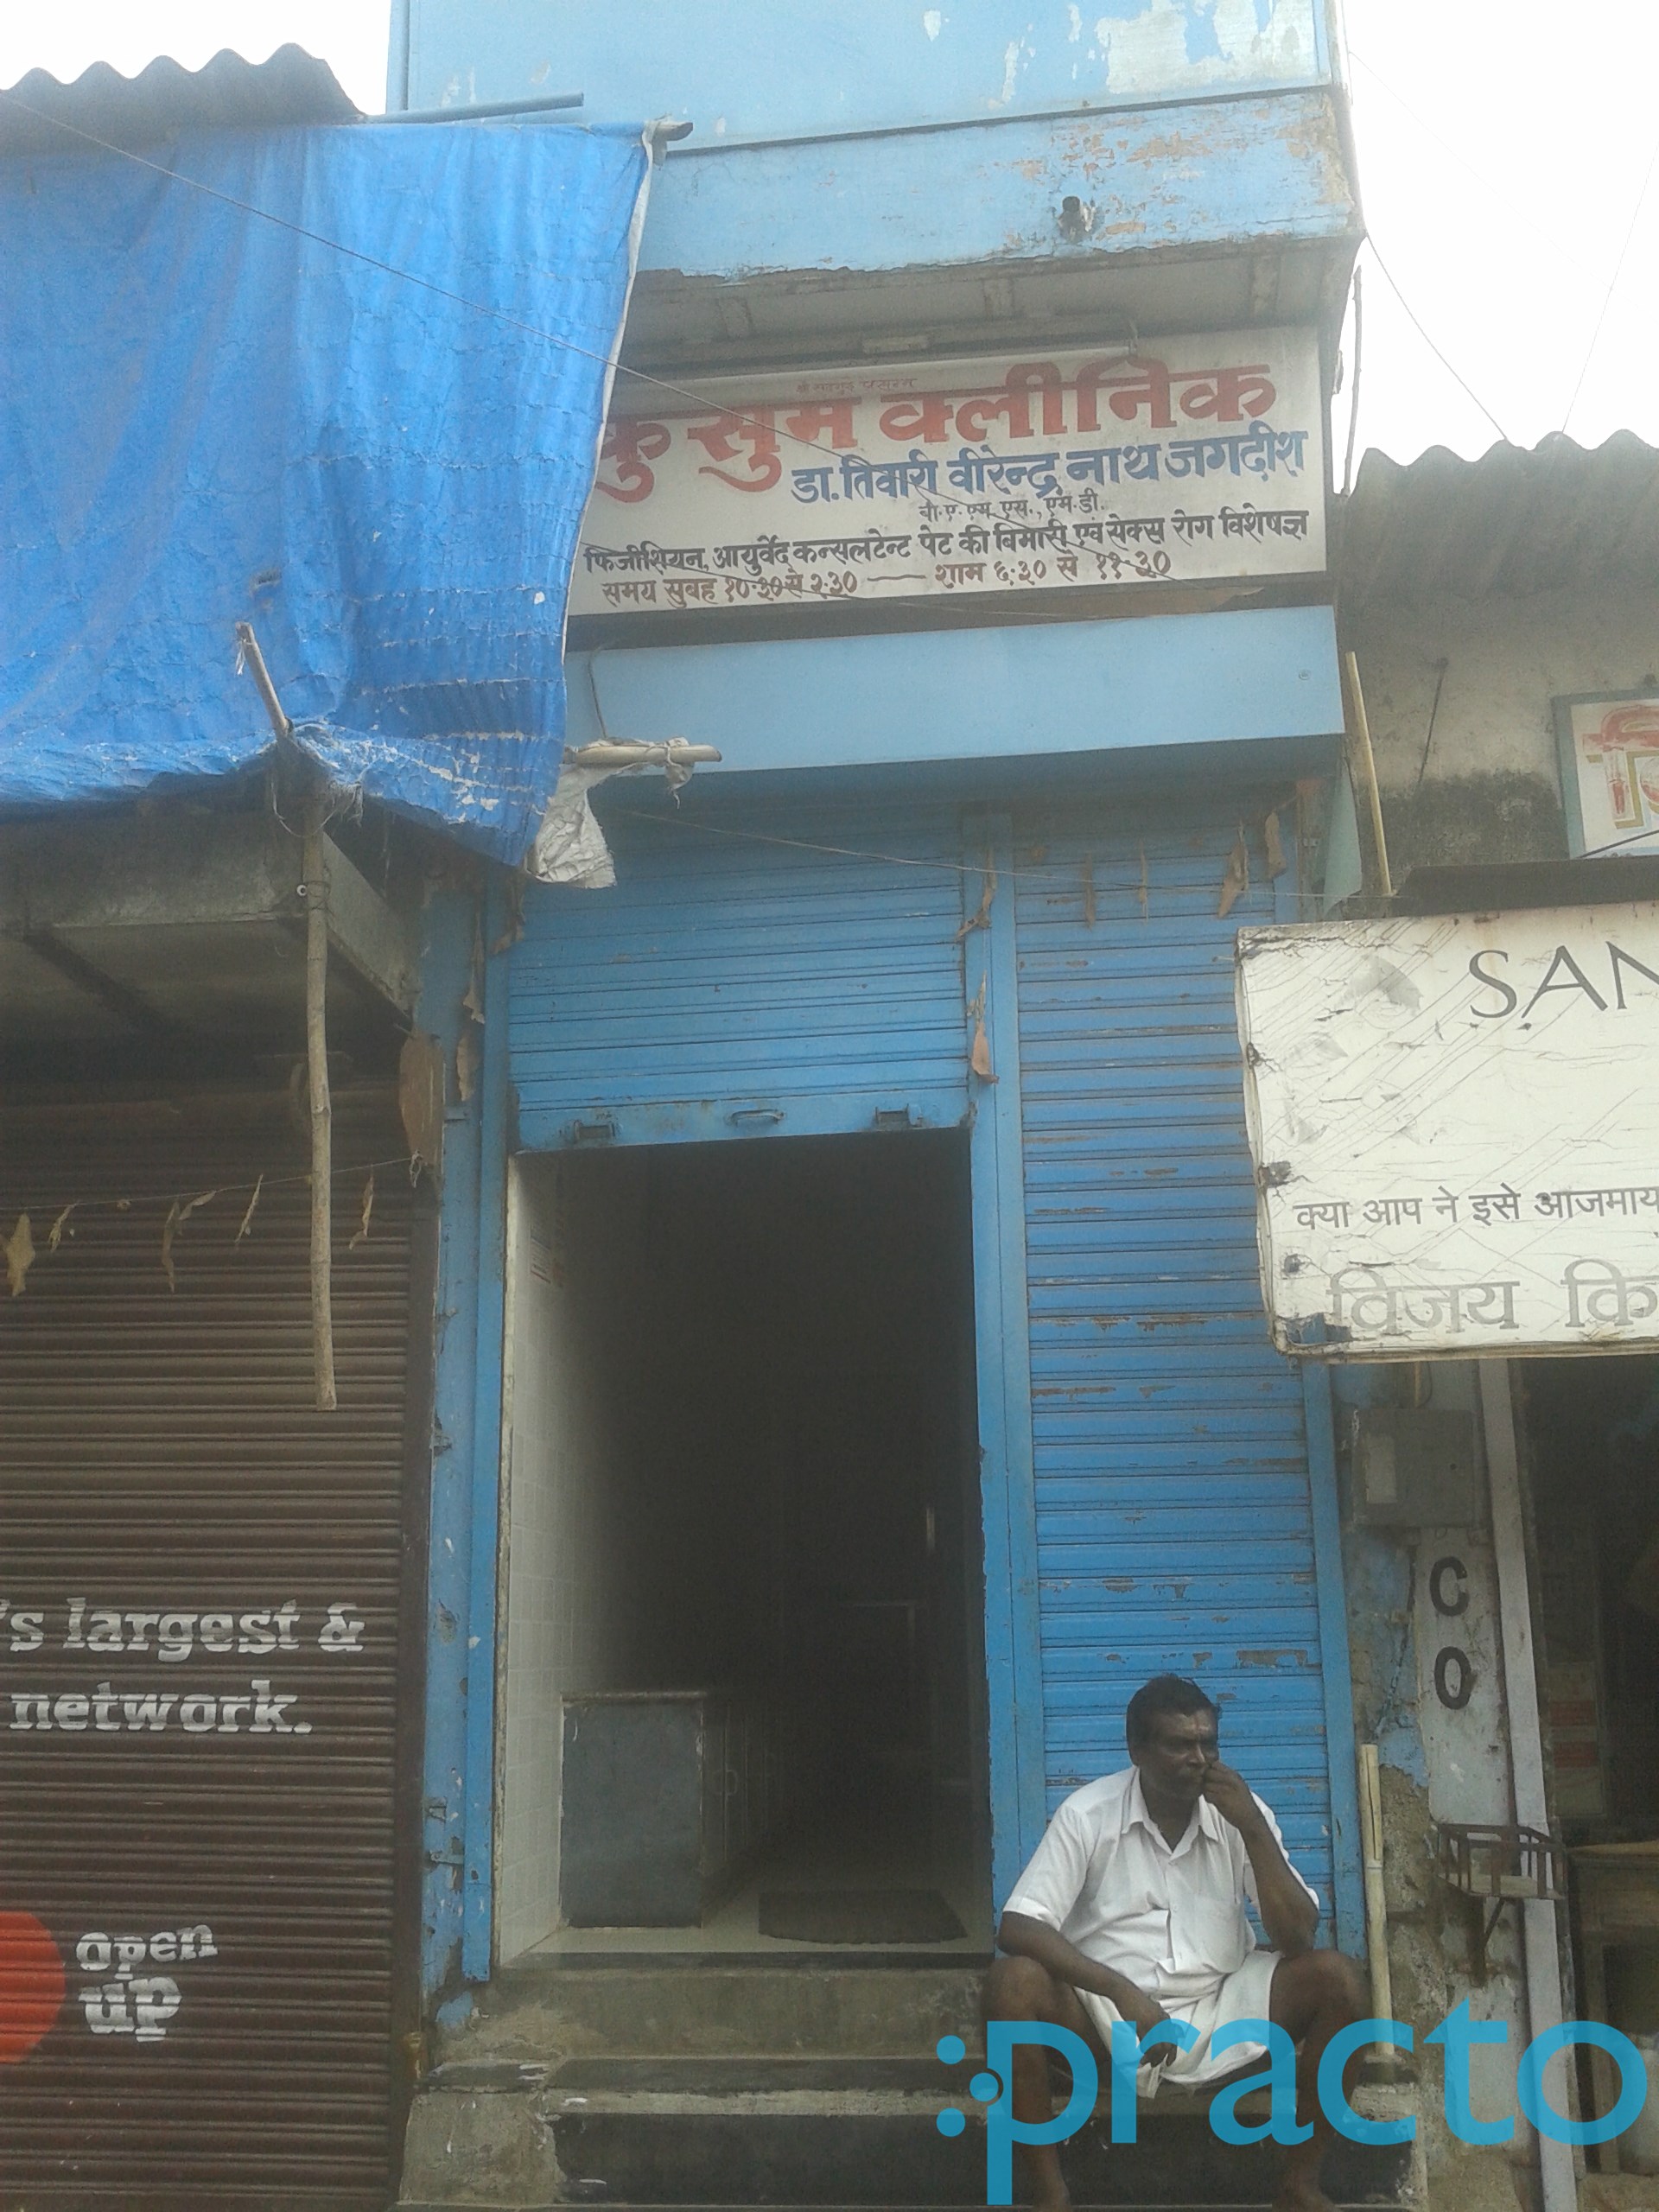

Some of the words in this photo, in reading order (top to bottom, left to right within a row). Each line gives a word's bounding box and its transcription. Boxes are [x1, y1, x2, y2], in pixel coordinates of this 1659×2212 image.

[880, 357, 1276, 444] क्लीनिक
[947, 444, 1059, 499] वीरेन्द्र
[1066, 444, 1161, 487] नाथ
[1165, 420, 1308, 481] जगदीश
[918, 524, 954, 556] पेट
[958, 524, 991, 555] की
[1106, 513, 1165, 550] सेक्स
[1171, 509, 1215, 546] रोग
[1218, 502, 1309, 543] विशेषज्ञ
[602, 580, 657, 607] समय
[935, 563, 987, 588] शाम
[1057, 550, 1079, 582] से
[1293, 1202, 1350, 1230] क्या
[1363, 1198, 1423, 1226] आप
[1432, 1185, 1459, 1223] ने
[1469, 1182, 1521, 1226] इसे
[1326, 1267, 1521, 1334] विजय
[63, 1597, 300, 1662] largest
[318, 1602, 365, 1652] &
[10, 1680, 313, 1734] network.
[76, 1923, 218, 1980] open
[79, 1976, 182, 2042] up
